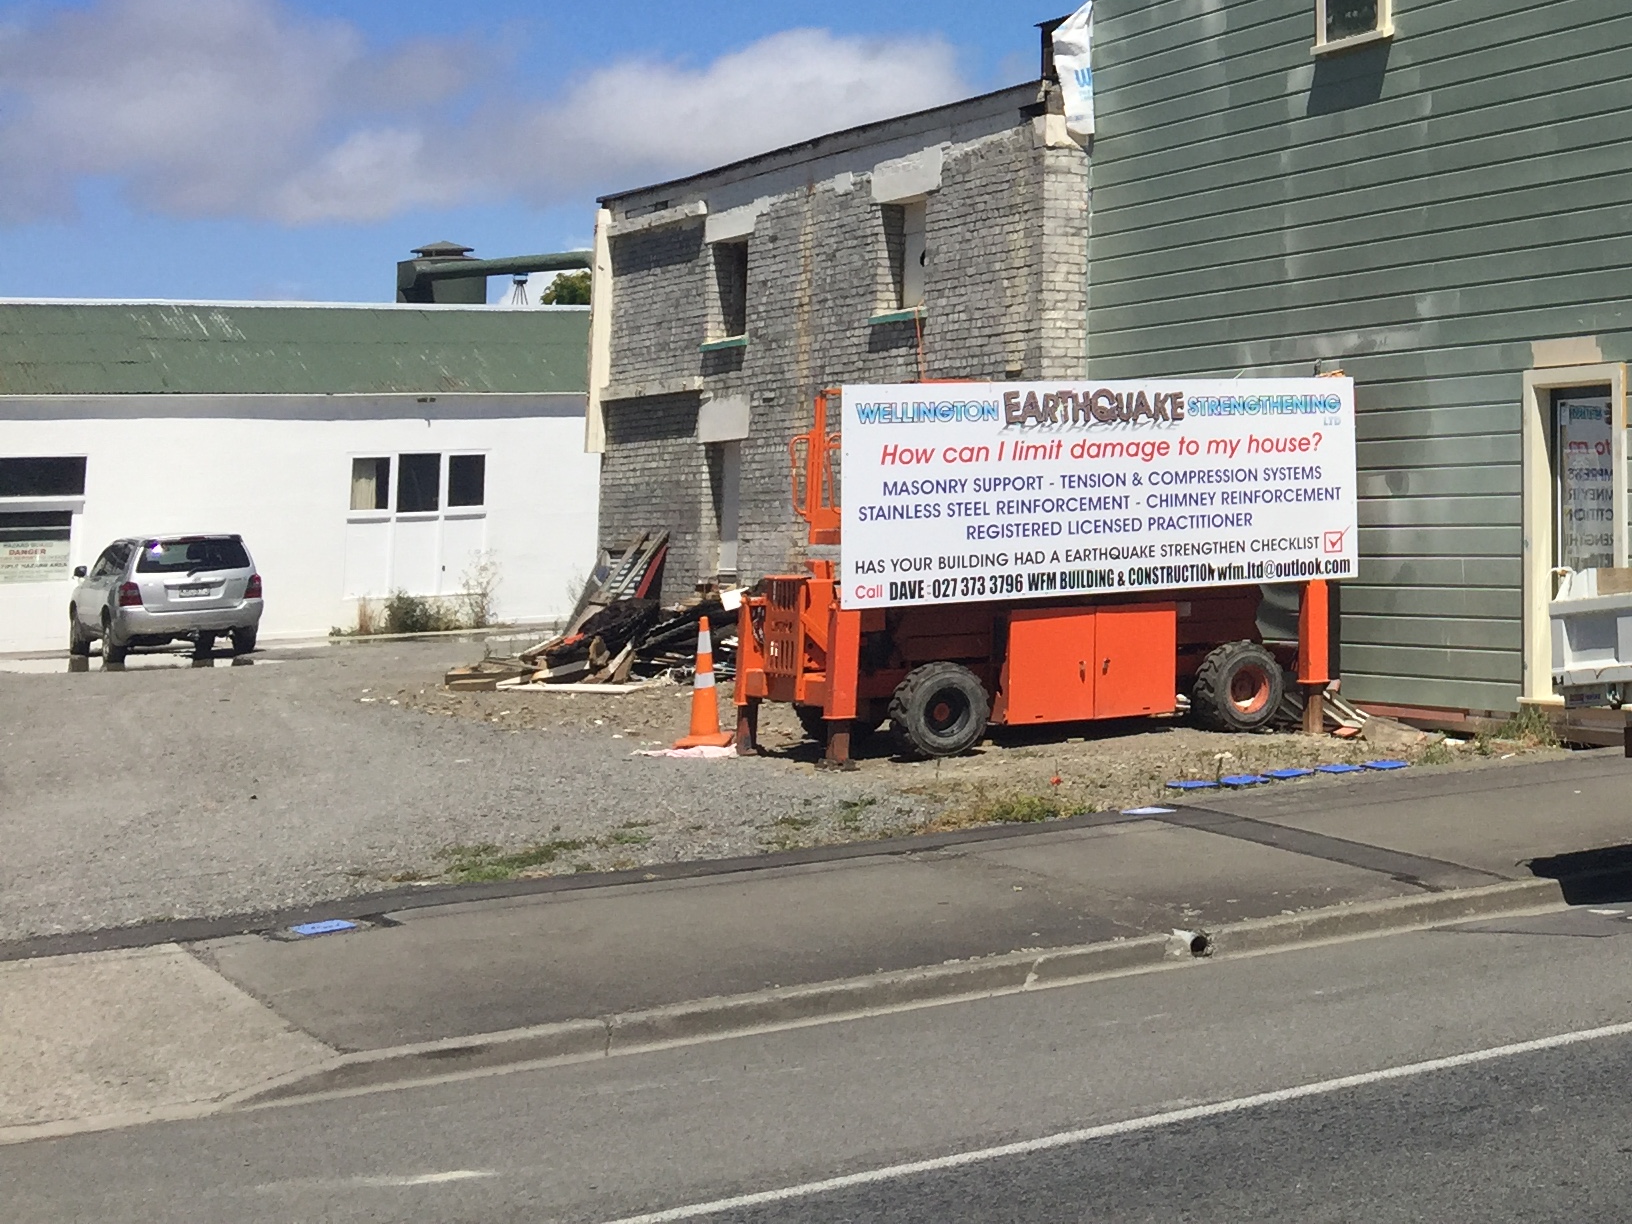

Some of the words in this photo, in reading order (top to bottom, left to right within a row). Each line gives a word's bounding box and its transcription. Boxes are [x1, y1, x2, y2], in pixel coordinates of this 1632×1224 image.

[855, 400, 999, 424] WELLINGTON
[1003, 388, 1185, 425] EARTHQUAKE
[1187, 394, 1341, 416] STRENGTHENING
[1323, 417, 1341, 426] LTD
[880, 444, 935, 466] How
[943, 445, 989, 464] can
[997, 441, 1005, 462] I
[1012, 439, 1064, 461] limit
[1070, 438, 1171, 463] damage
[1178, 436, 1200, 456] to
[1206, 437, 1241, 458] my
[1247, 432, 1323, 453] house?
[882, 478, 968, 496] MASONRY
[973, 475, 1044, 493] SUPPORT
[1060, 473, 1127, 489] TENSION
[1132, 472, 1143, 487] &
[1148, 468, 1258, 486] COMPRESSION
[1263, 466, 1322, 481] SYSTEMS
[858, 503, 941, 521] STAINLESS
[947, 501, 990, 518] STEEL
[996, 495, 1130, 515] REINFORCEMENT
[1146, 492, 1216, 509] CHIMNEY
[1221, 487, 1341, 505] REINFORCEMENT
[966, 521, 1062, 540] REGISTERED
[1068, 517, 1142, 536] LICENSED
[1148, 512, 1253, 531] PRACTITIONER
[855, 560, 885, 574] HAS
[891, 557, 933, 573] YOUR
[938, 552, 1009, 570] BUILDING
[1014, 550, 1046, 566] HAD
[1050, 550, 1060, 564] A
[1065, 545, 1155, 563] EARTHQUAKE
[1160, 540, 1246, 558] STRENGTHEN
[1250, 536, 1320, 552] CHECKLIST
[855, 584, 883, 600] Call
[889, 580, 925, 601] DAVE
[932, 578, 957, 599] 027
[961, 576, 986, 597] 373
[989, 573, 1023, 595] 3796
[1027, 572, 1057, 592] WFM
[1060, 568, 1114, 590] BUILDING
[1117, 571, 1126, 587] &
[1128, 563, 1215, 586] CONSTRUCTION
[1218, 557, 1351, 581] wfm.ltd@outlook.com
